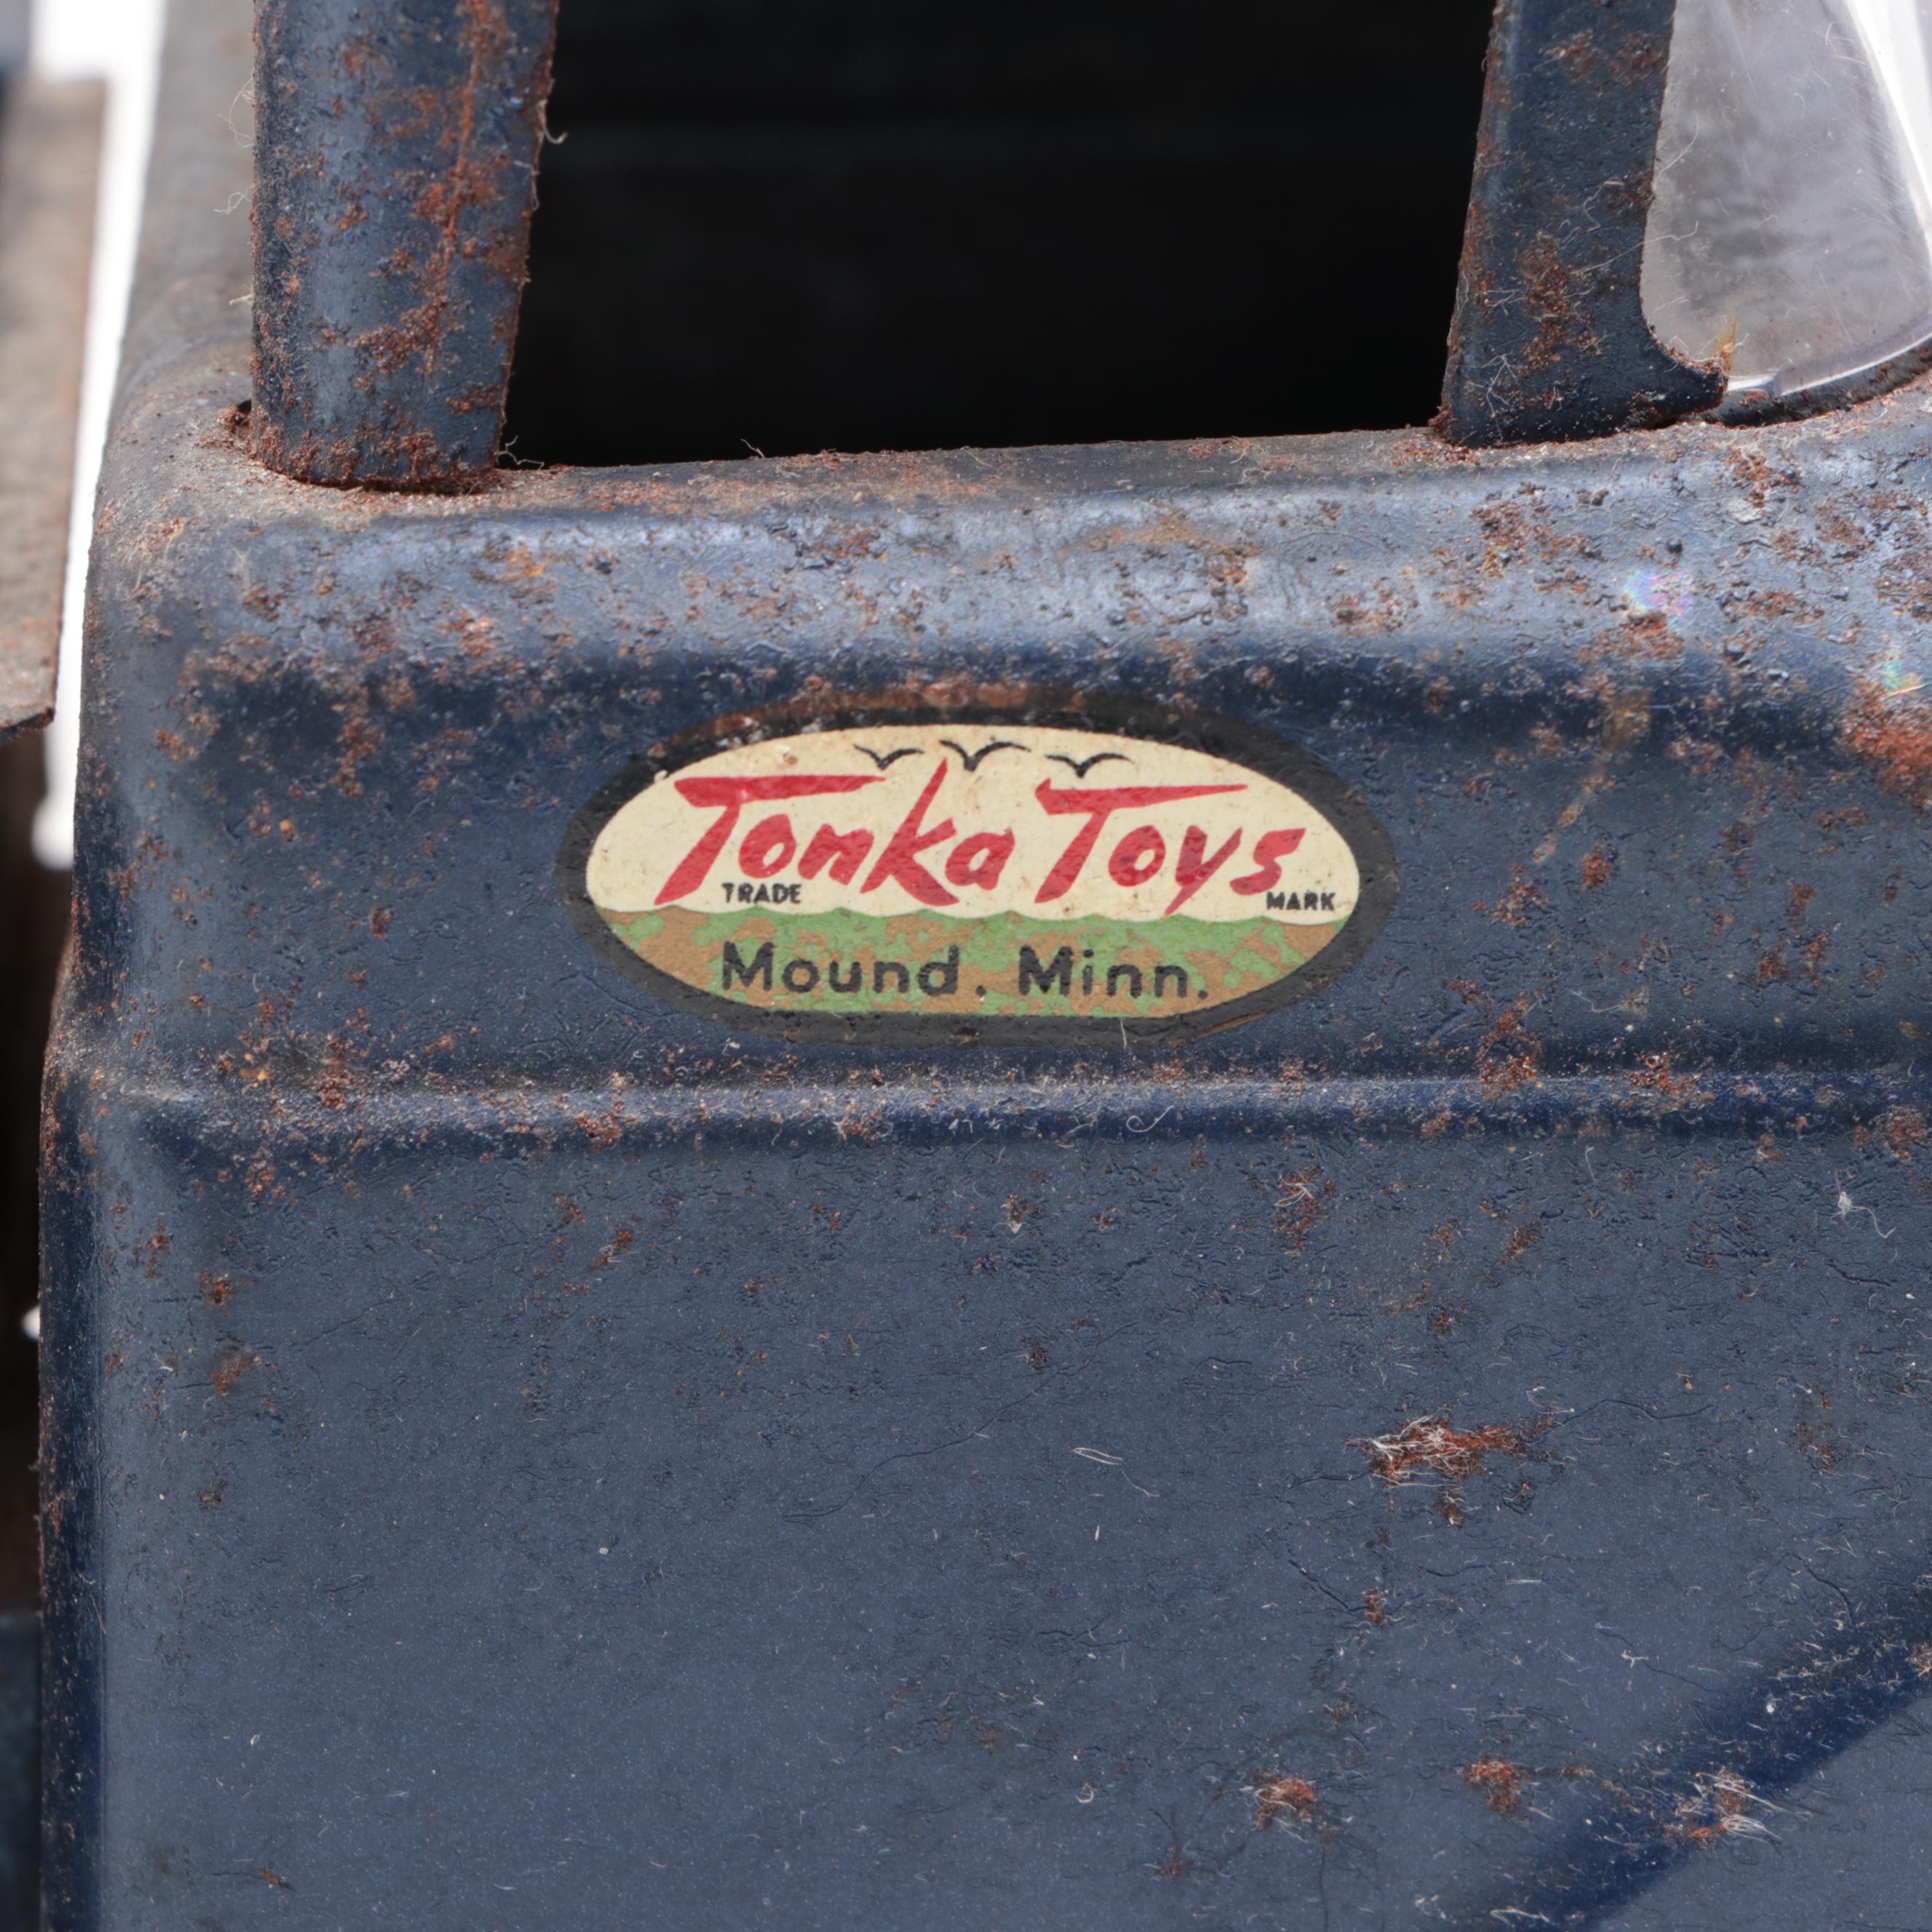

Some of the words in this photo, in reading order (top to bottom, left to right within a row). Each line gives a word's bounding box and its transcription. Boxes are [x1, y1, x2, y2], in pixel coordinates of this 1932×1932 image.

[654, 757, 1015, 906] Tonka
[1034, 778, 1306, 916] Toys
[722, 882, 802, 903] TRADE
[1266, 892, 1336, 911] MARK
[1019, 946, 1209, 999] Minn.
